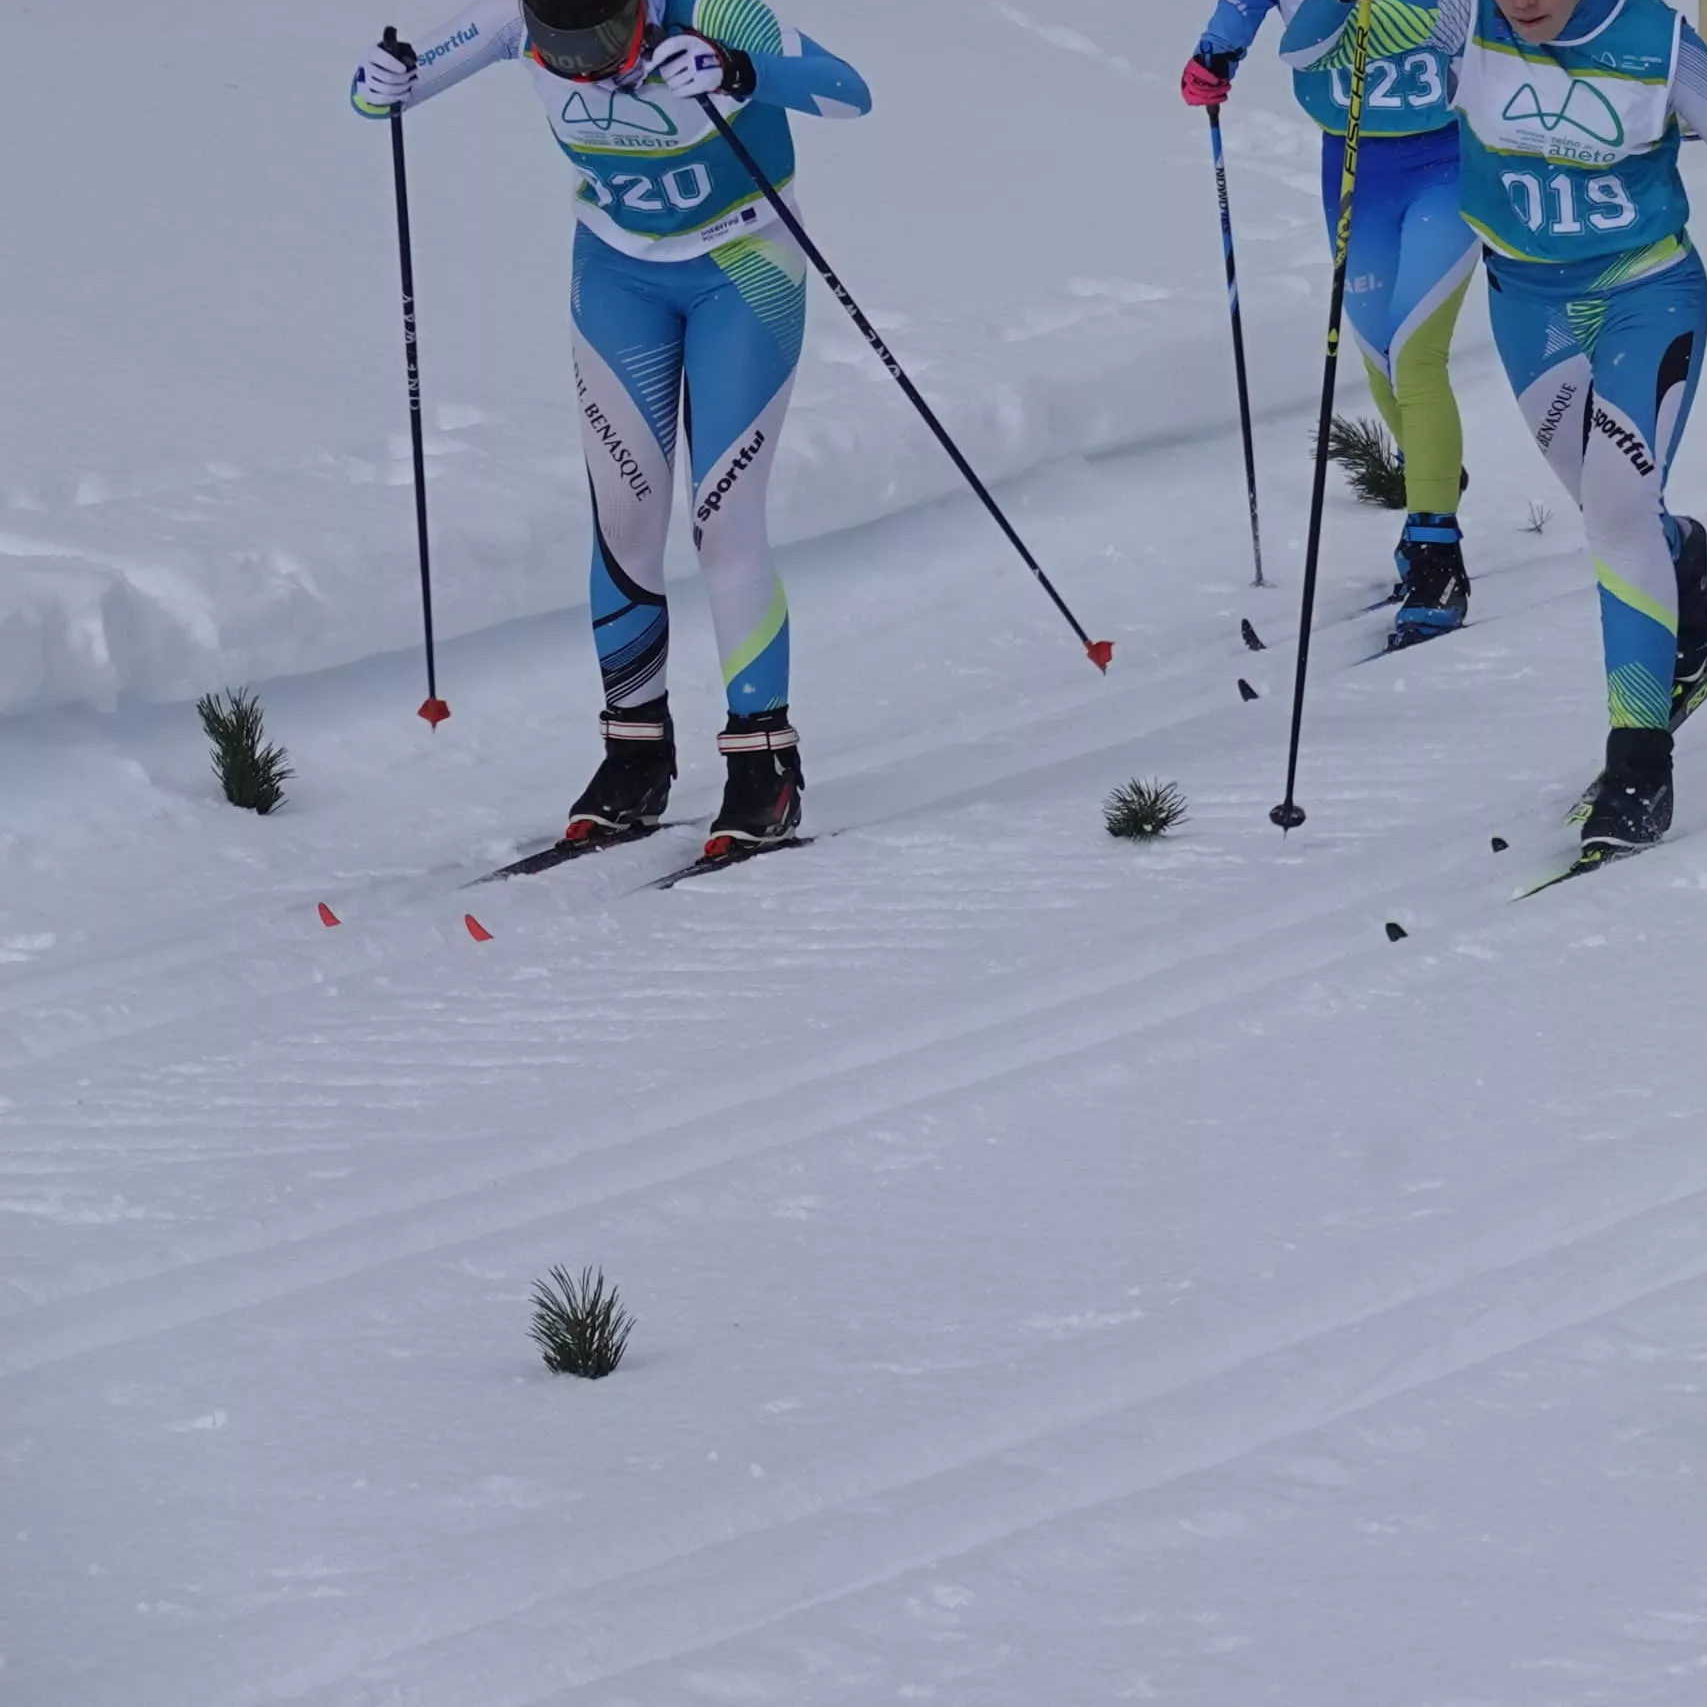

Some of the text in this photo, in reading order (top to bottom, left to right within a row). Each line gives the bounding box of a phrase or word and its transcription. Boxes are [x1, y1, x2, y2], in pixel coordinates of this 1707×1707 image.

[417, 23, 480, 67] sportful
[1344, 25, 1370, 175] FISCHER
[1548, 144, 1616, 164] aneto
[1499, 170, 1641, 237] 019
[584, 402, 653, 502] BENASQUE
[696, 429, 766, 522] sportful
